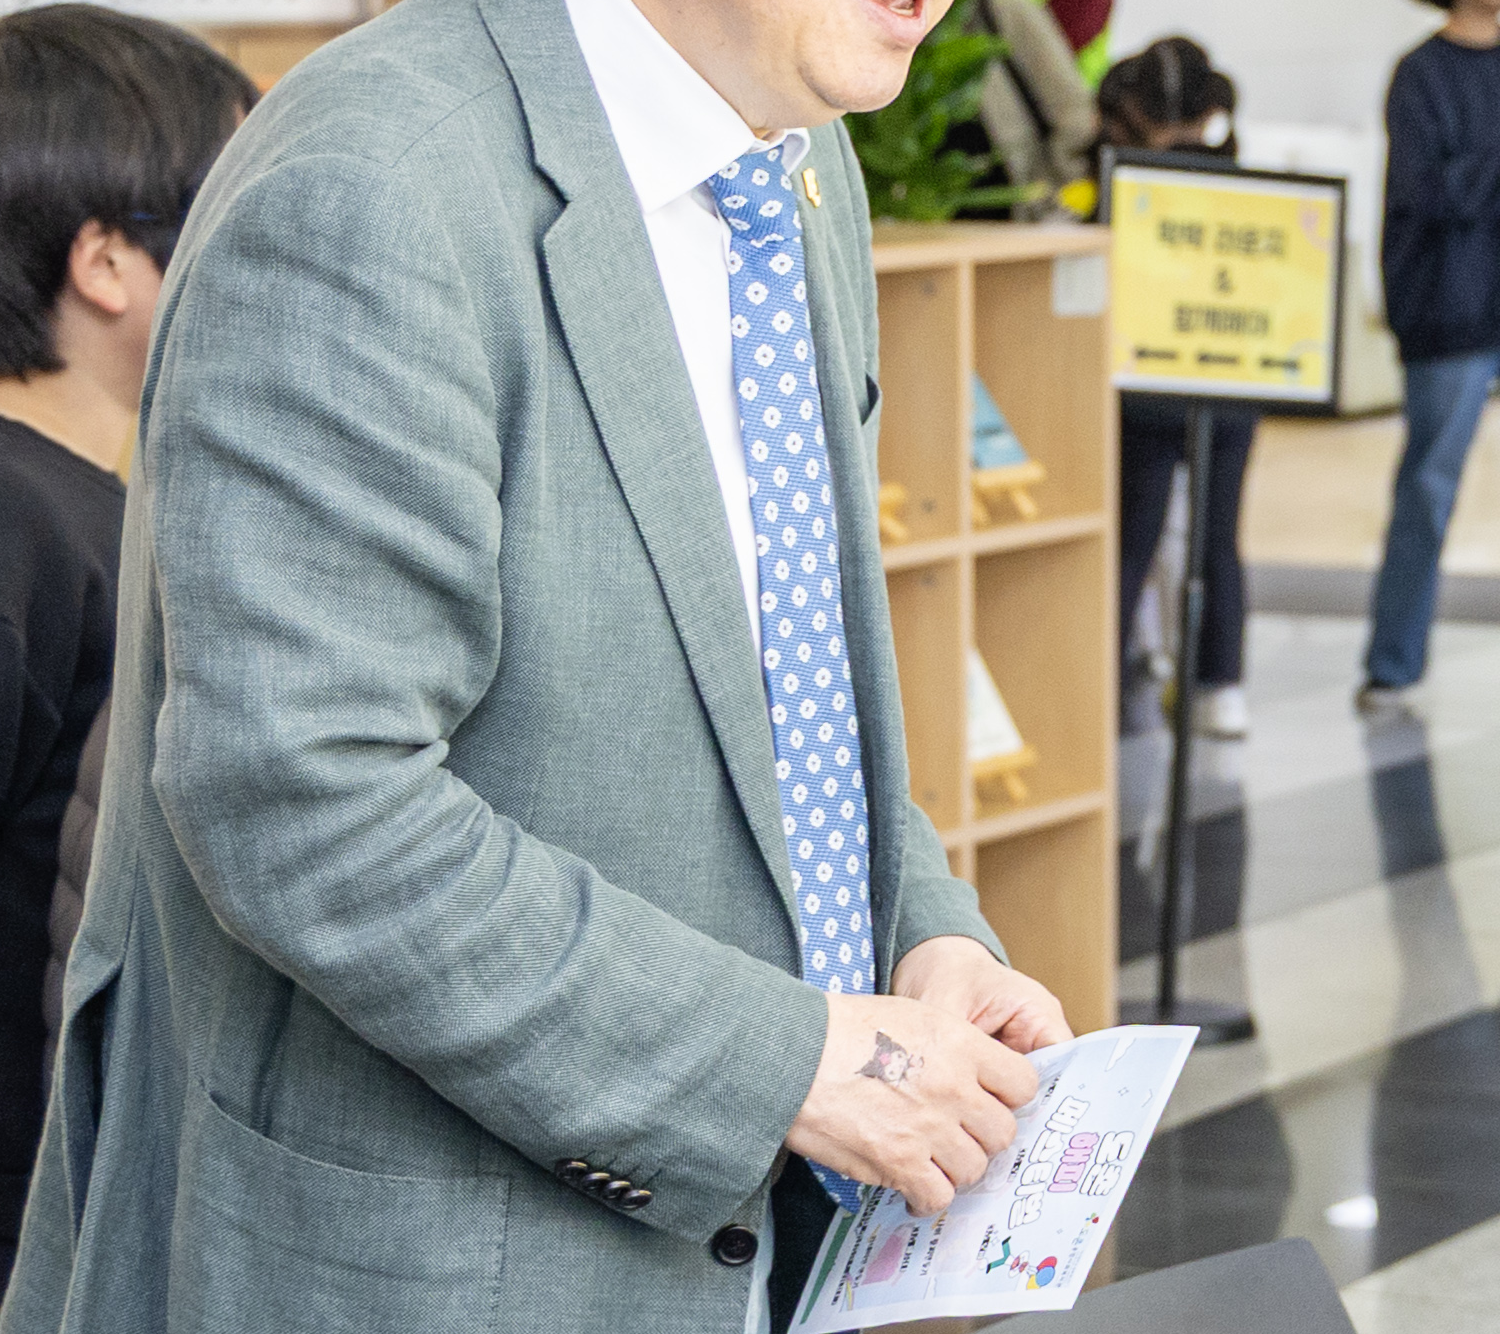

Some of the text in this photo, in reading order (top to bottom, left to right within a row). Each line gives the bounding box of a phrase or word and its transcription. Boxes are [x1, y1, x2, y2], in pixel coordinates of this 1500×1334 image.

[1008, 1095, 1091, 1230] 페스티벌
[1047, 1131, 1100, 1193] 해피
[1079, 1130, 1135, 1196] 도촌
